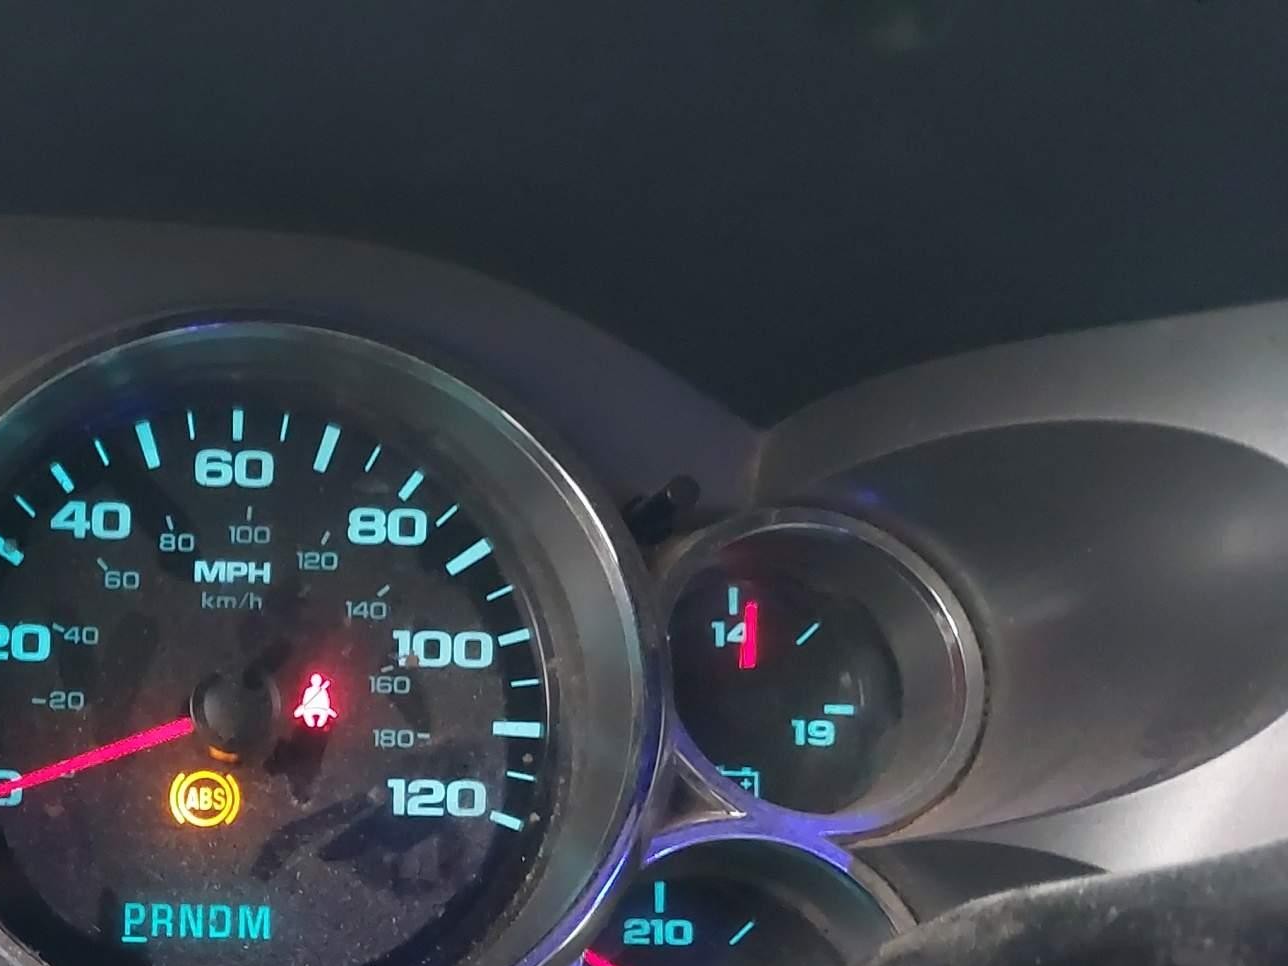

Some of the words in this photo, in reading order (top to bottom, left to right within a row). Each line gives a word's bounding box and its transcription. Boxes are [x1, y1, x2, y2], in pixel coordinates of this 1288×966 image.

[195, 449, 274, 488] 60
[50, 501, 131, 539] 40
[348, 508, 428, 546] 80
[159, 530, 194, 552] 80
[229, 525, 271, 544] 100
[194, 560, 271, 584] MPH
[298, 551, 338, 571] 120
[104, 570, 140, 590] 60
[201, 591, 263, 611] km/h
[346, 600, 387, 620] 140
[63, 626, 99, 645] 40
[392, 629, 493, 669] 100
[370, 675, 411, 694] 160
[49, 691, 85, 711] 20
[373, 729, 414, 748] 180
[792, 719, 836, 747] 19
[186, 787, 226, 811] ABS
[388, 779, 487, 817] 120
[122, 903, 271, 942] PRNDM
[624, 918, 694, 946] 210
